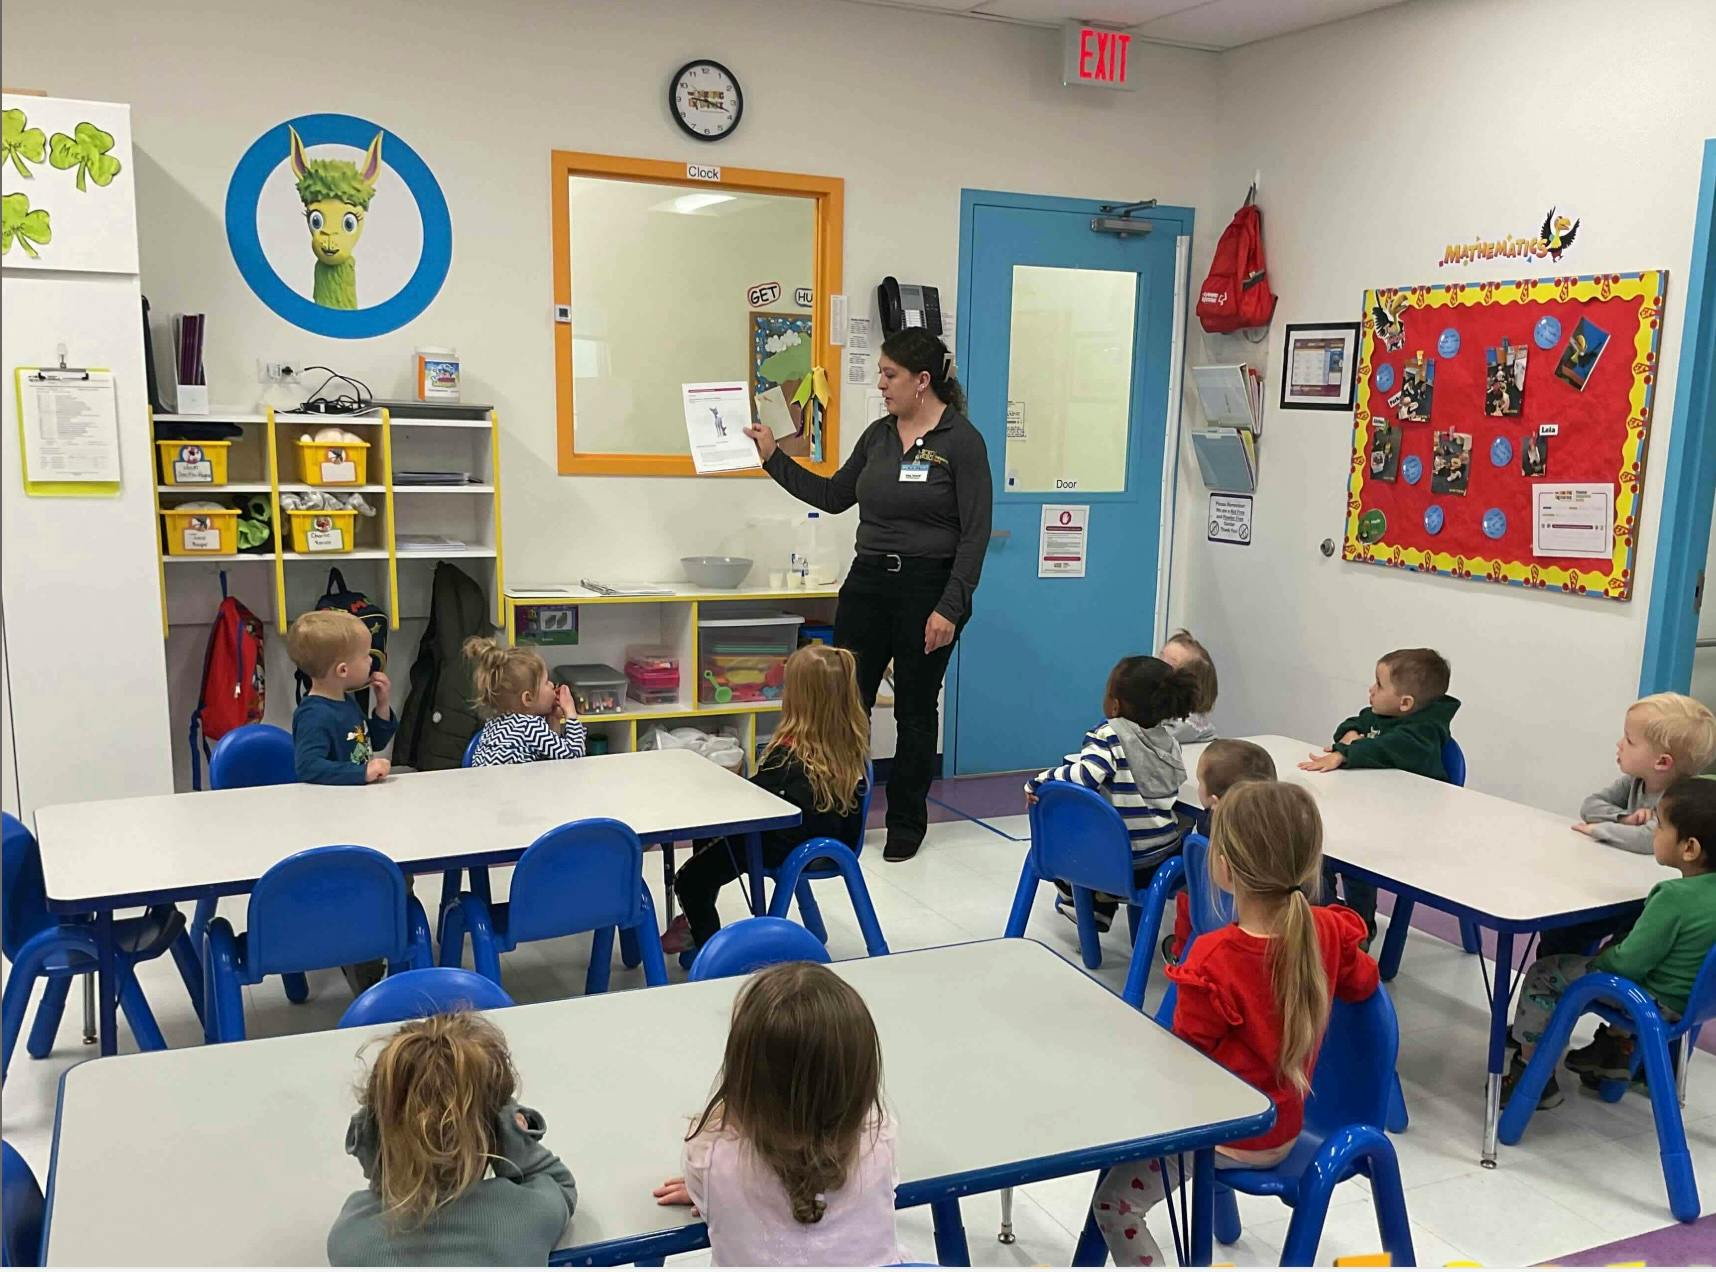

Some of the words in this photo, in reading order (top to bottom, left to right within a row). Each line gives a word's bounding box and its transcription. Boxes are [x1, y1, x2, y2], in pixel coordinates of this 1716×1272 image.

[1080, 29, 1131, 82] EXIT
[676, 95, 682, 103] 9
[688, 165, 719, 180] Clock
[1443, 238, 1549, 264] MATHEMATICS
[750, 285, 778, 304] GET
[1056, 479, 1077, 489] Door
